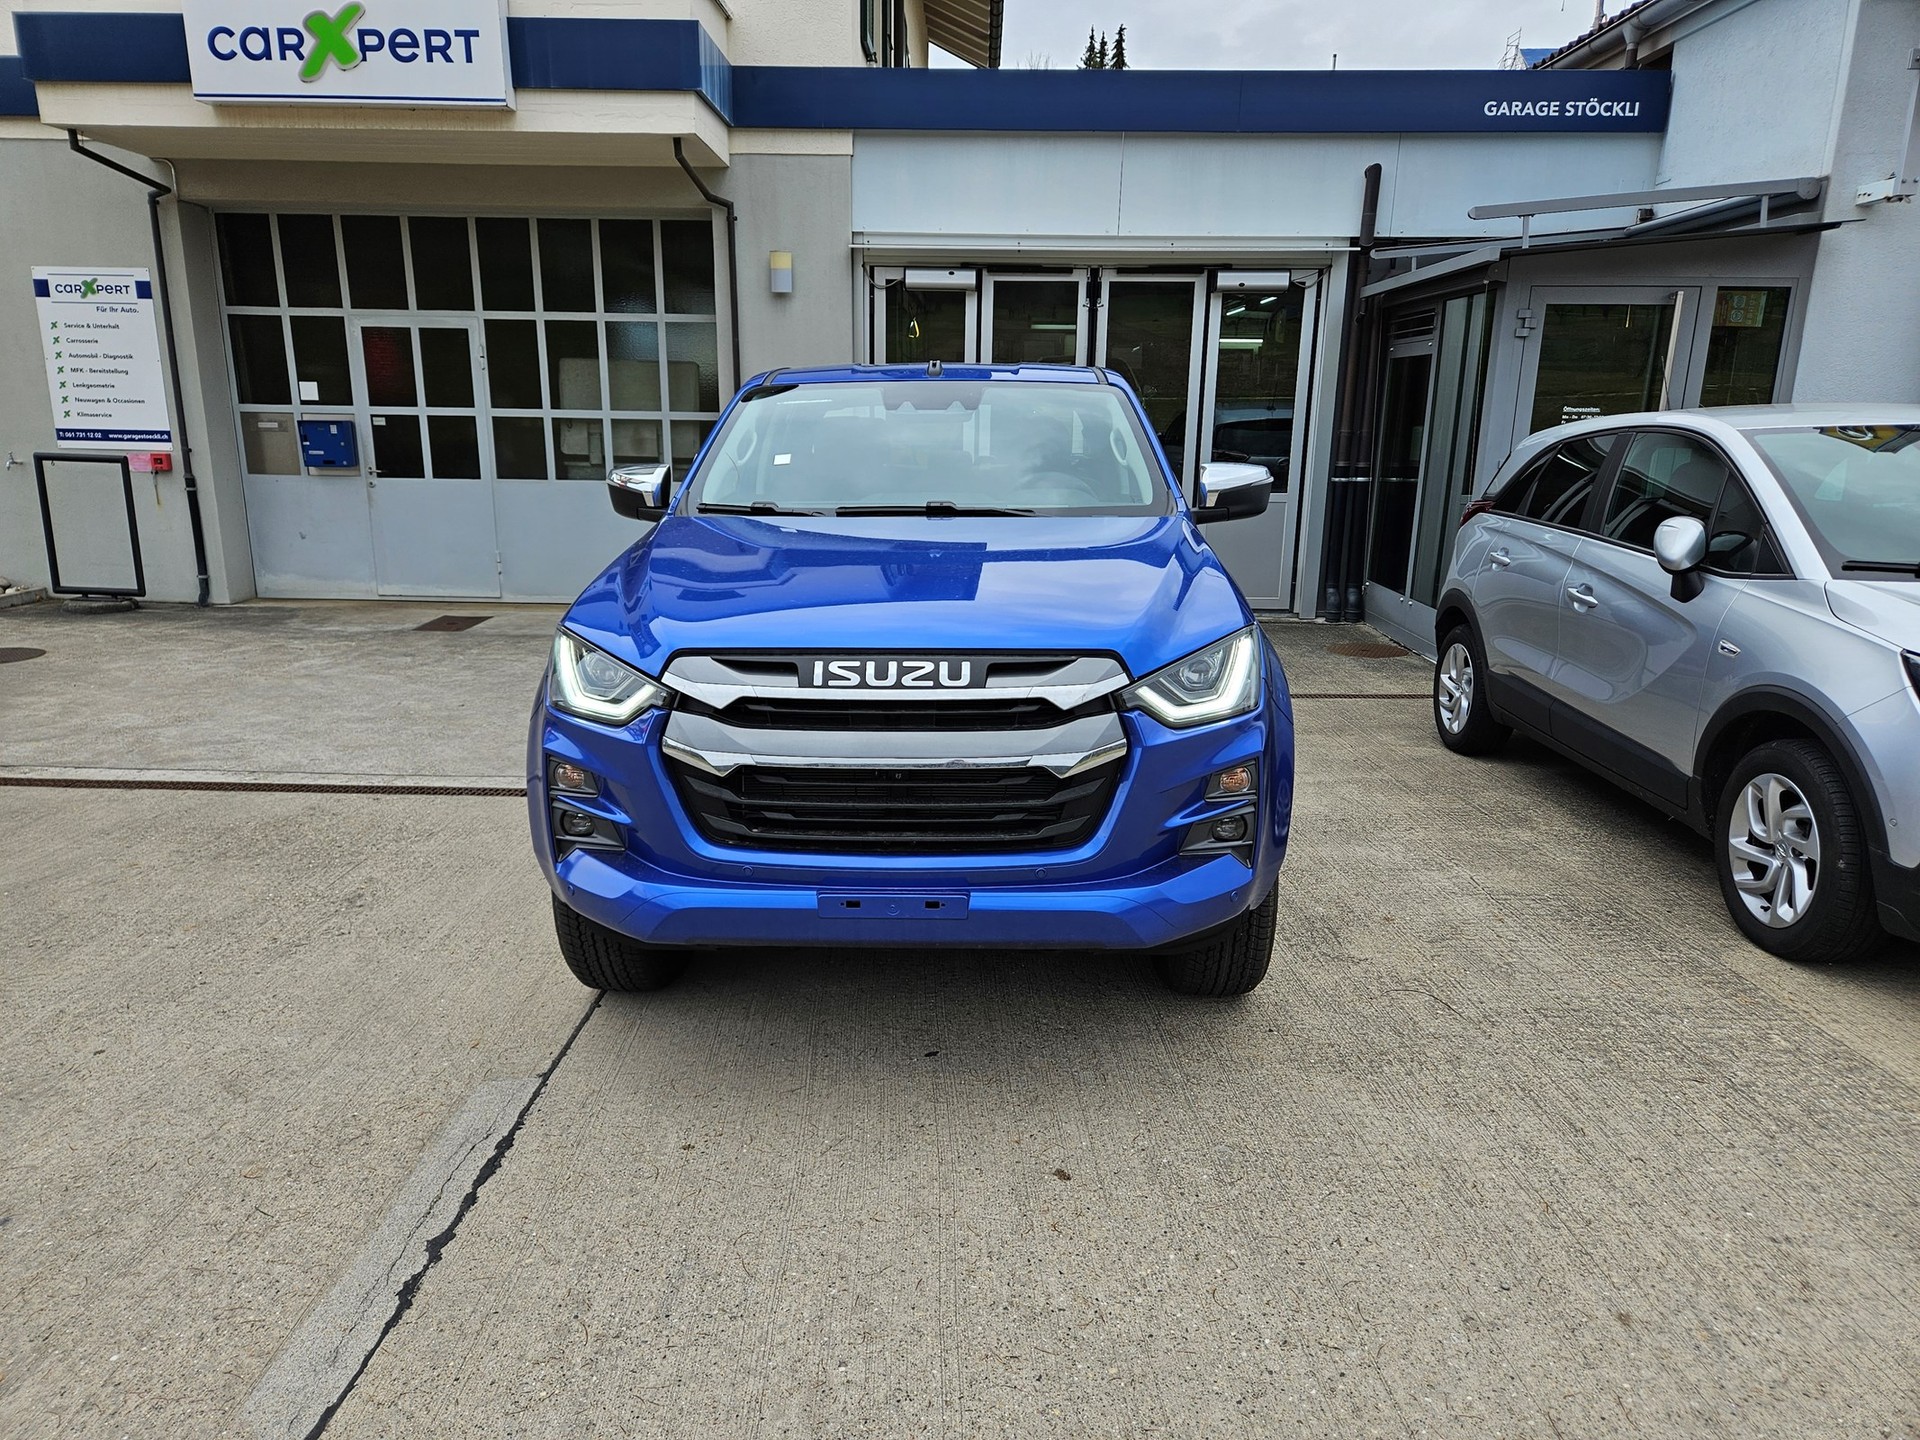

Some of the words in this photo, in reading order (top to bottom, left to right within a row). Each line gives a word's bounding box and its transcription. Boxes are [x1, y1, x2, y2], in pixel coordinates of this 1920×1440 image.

[1484, 101, 1560, 116] GARAGE
[1564, 98, 1640, 117] STÖCKLI
[96, 305, 107, 313] Für
[120, 306, 140, 314] Auto.
[88, 368, 129, 376] Bereitstellung
[72, 382, 116, 390] Lenkgeometrie
[74, 397, 106, 405] Neuwagen
[813, 660, 971, 687] ISUZU
